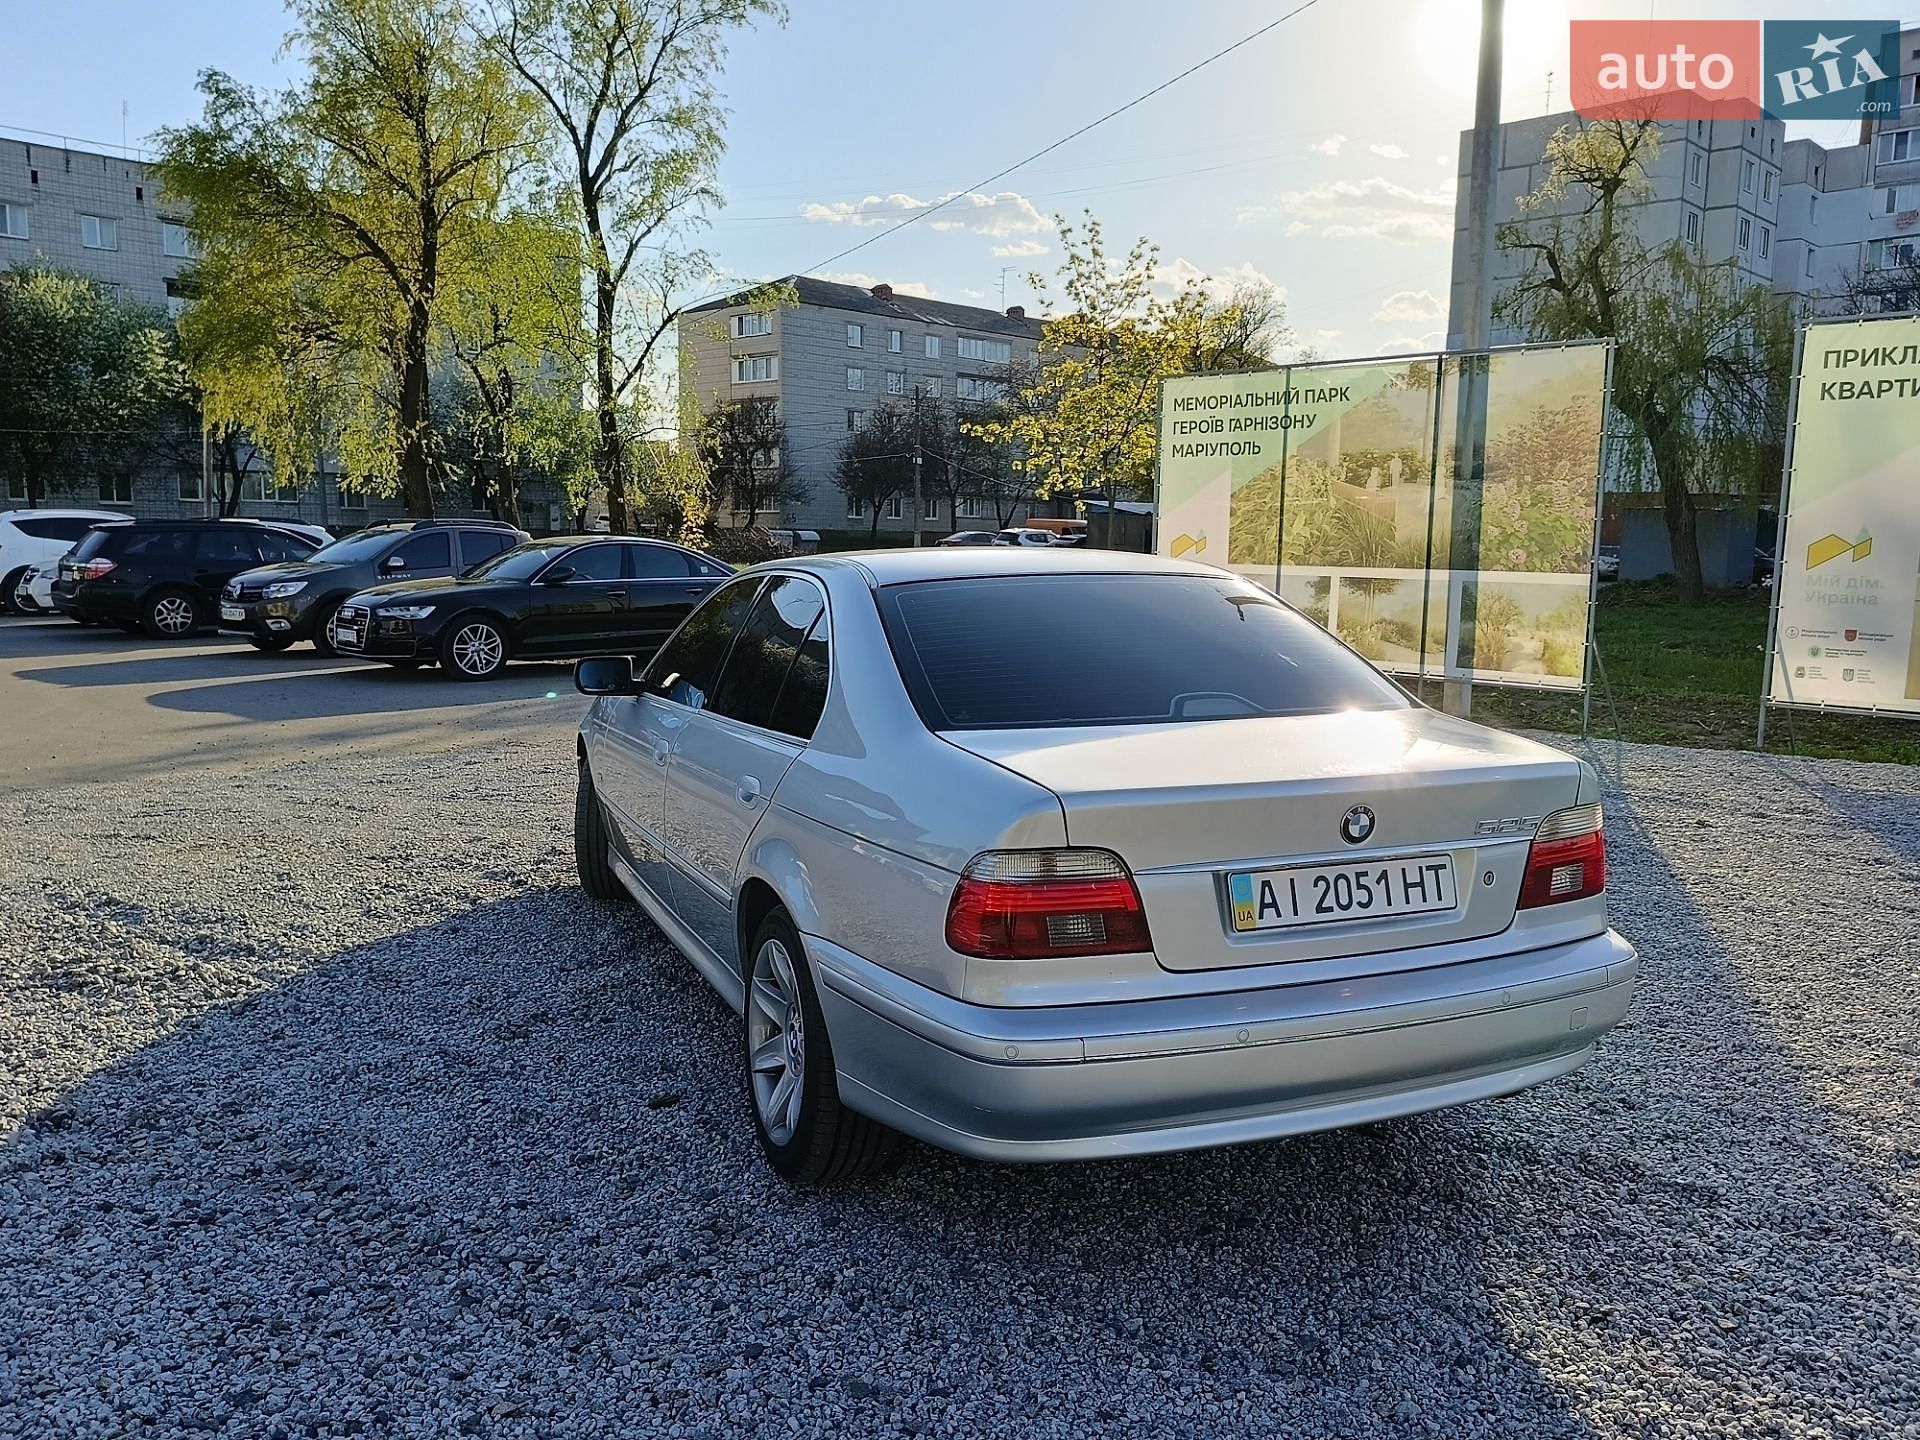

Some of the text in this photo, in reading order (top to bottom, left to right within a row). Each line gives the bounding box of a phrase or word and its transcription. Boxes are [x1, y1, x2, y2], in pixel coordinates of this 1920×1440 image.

[1823, 345, 1920, 369] ПРИКЛ
[1173, 386, 1350, 411] МЕМОРІАЛЬНИЙ ПАРК
[1173, 414, 1317, 435] ГЕРОЇВ ГАРНІЗОНУ
[1172, 441, 1261, 458] МАРІУПОЛЬ
[1347, 806, 1374, 820] BMW
[1257, 864, 1447, 920] AI 2051 HT
[1238, 910, 1254, 923] UA
